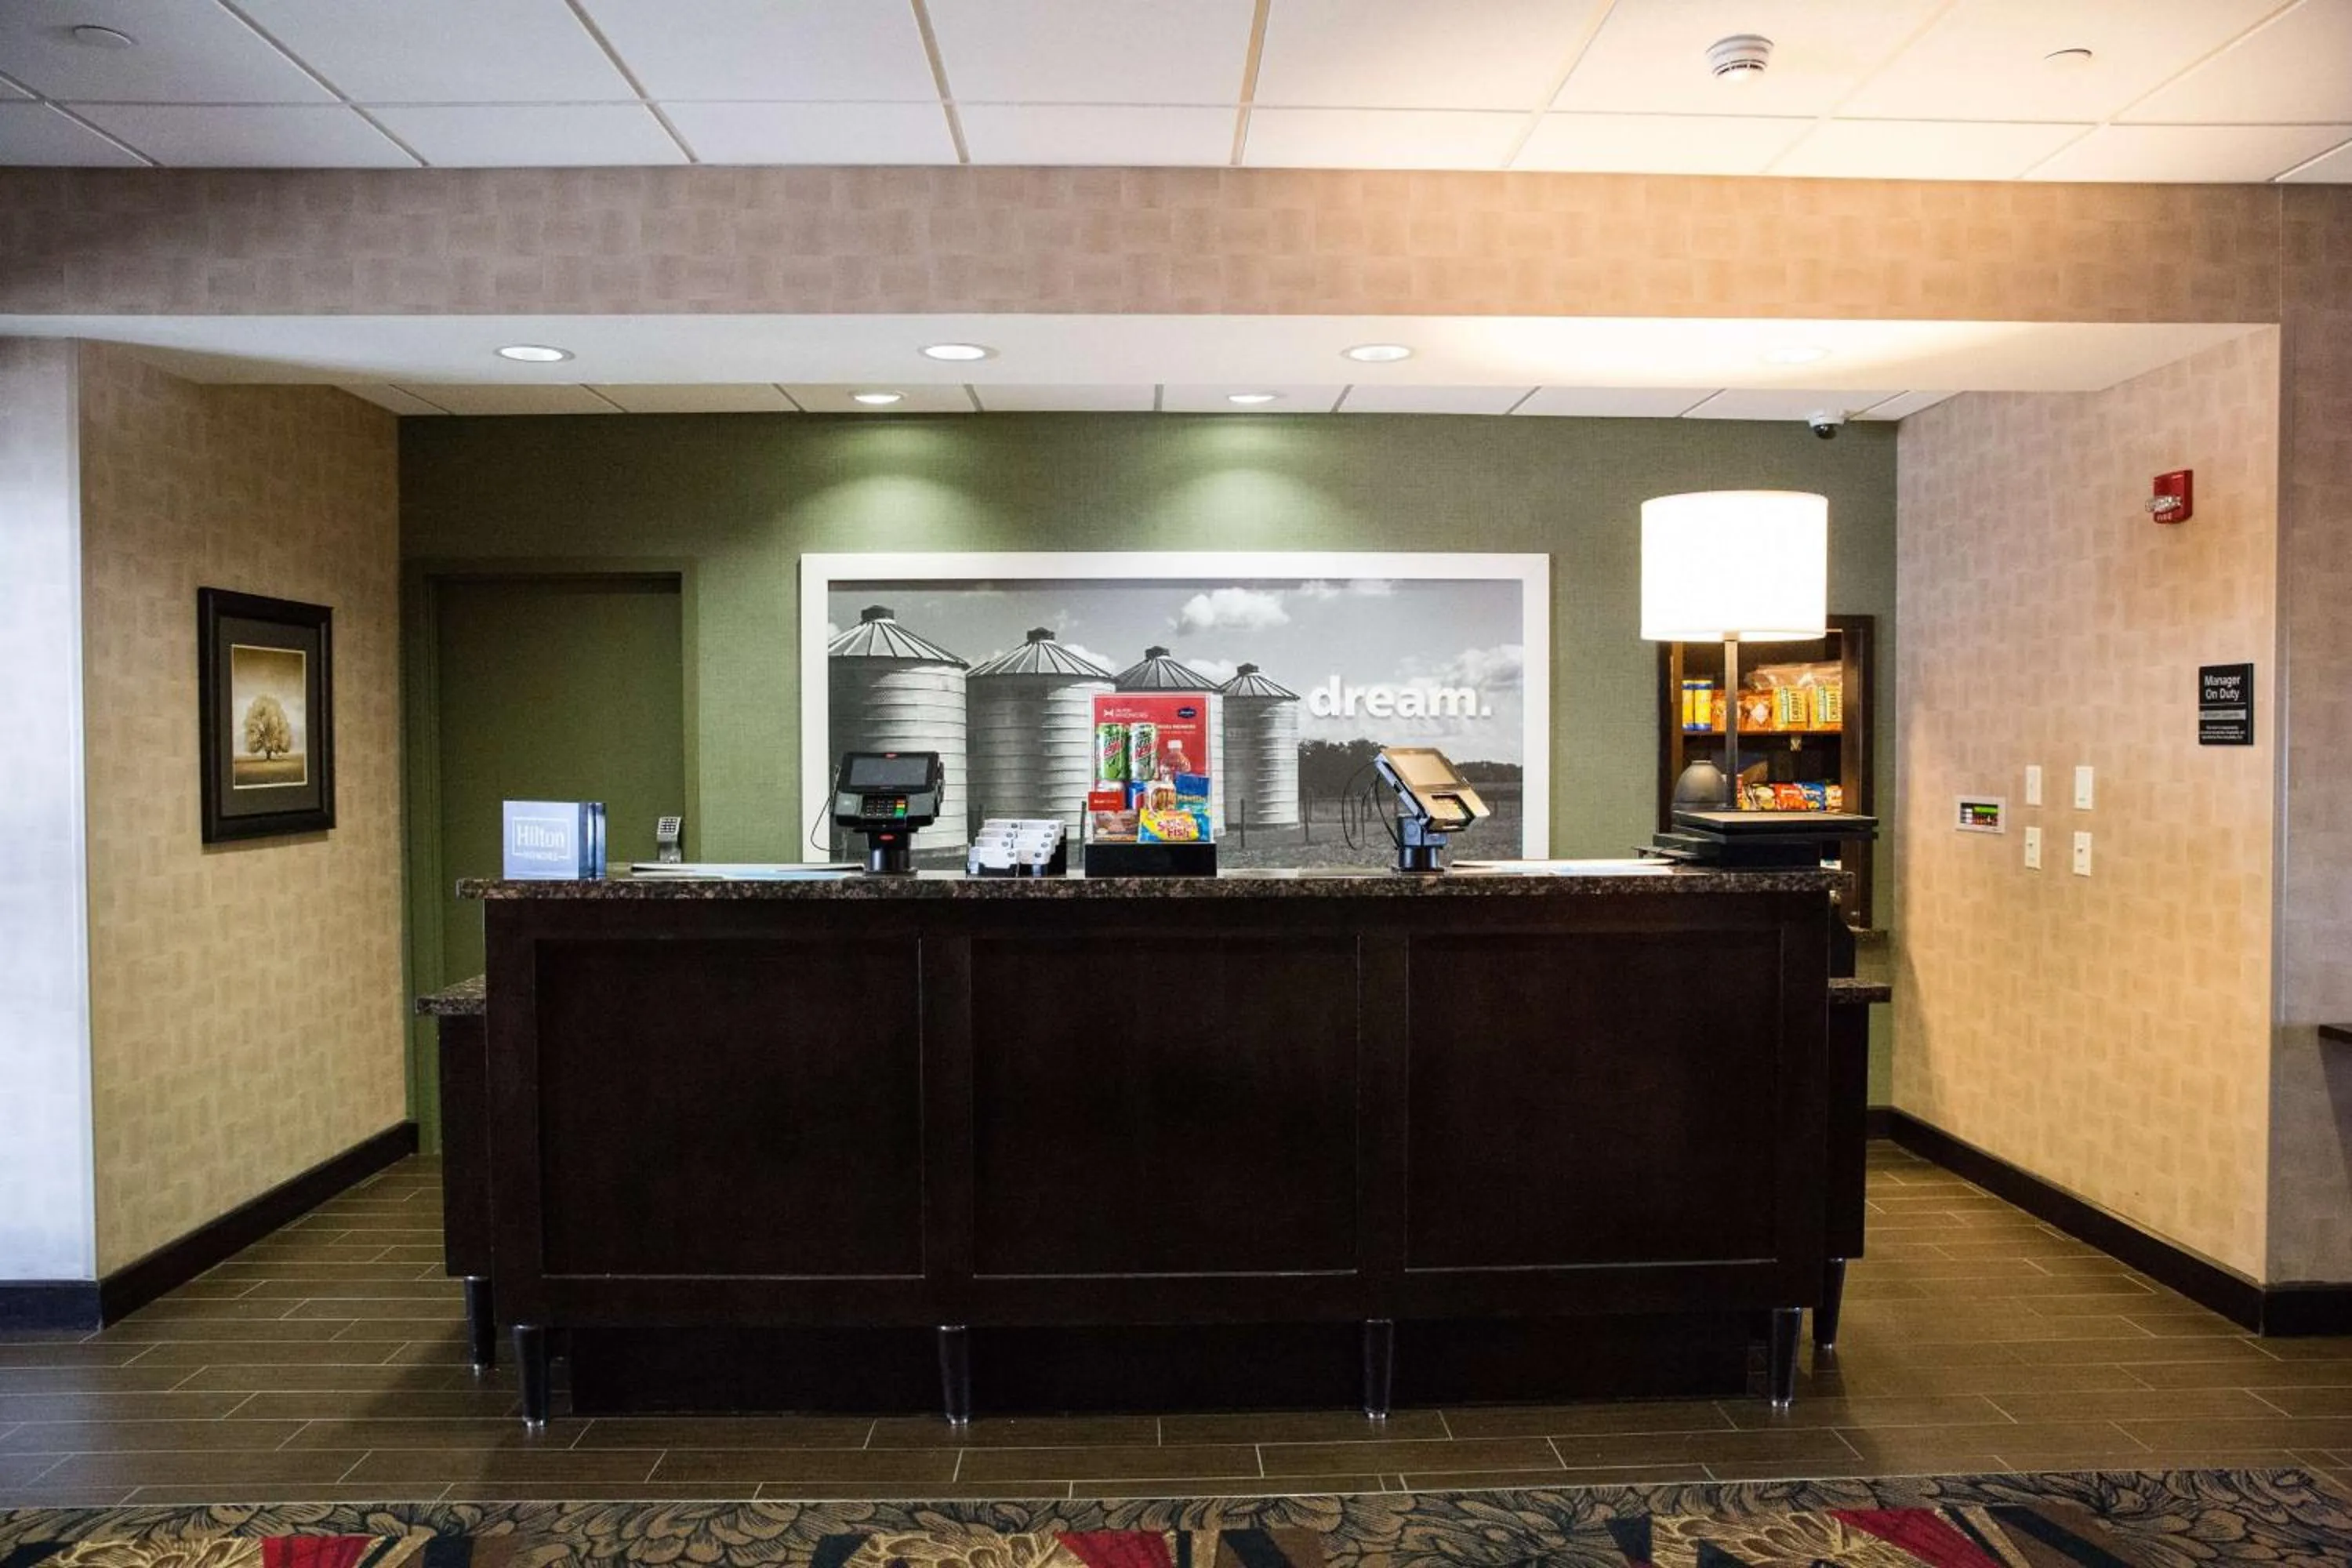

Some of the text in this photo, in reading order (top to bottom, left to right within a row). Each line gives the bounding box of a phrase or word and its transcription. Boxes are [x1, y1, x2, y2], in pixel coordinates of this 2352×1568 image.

[2204, 675, 2241, 688] Manager
[1308, 675, 1492, 717] dream.
[2205, 688, 2240, 702] On Duty
[517, 824, 565, 848] Hilton
